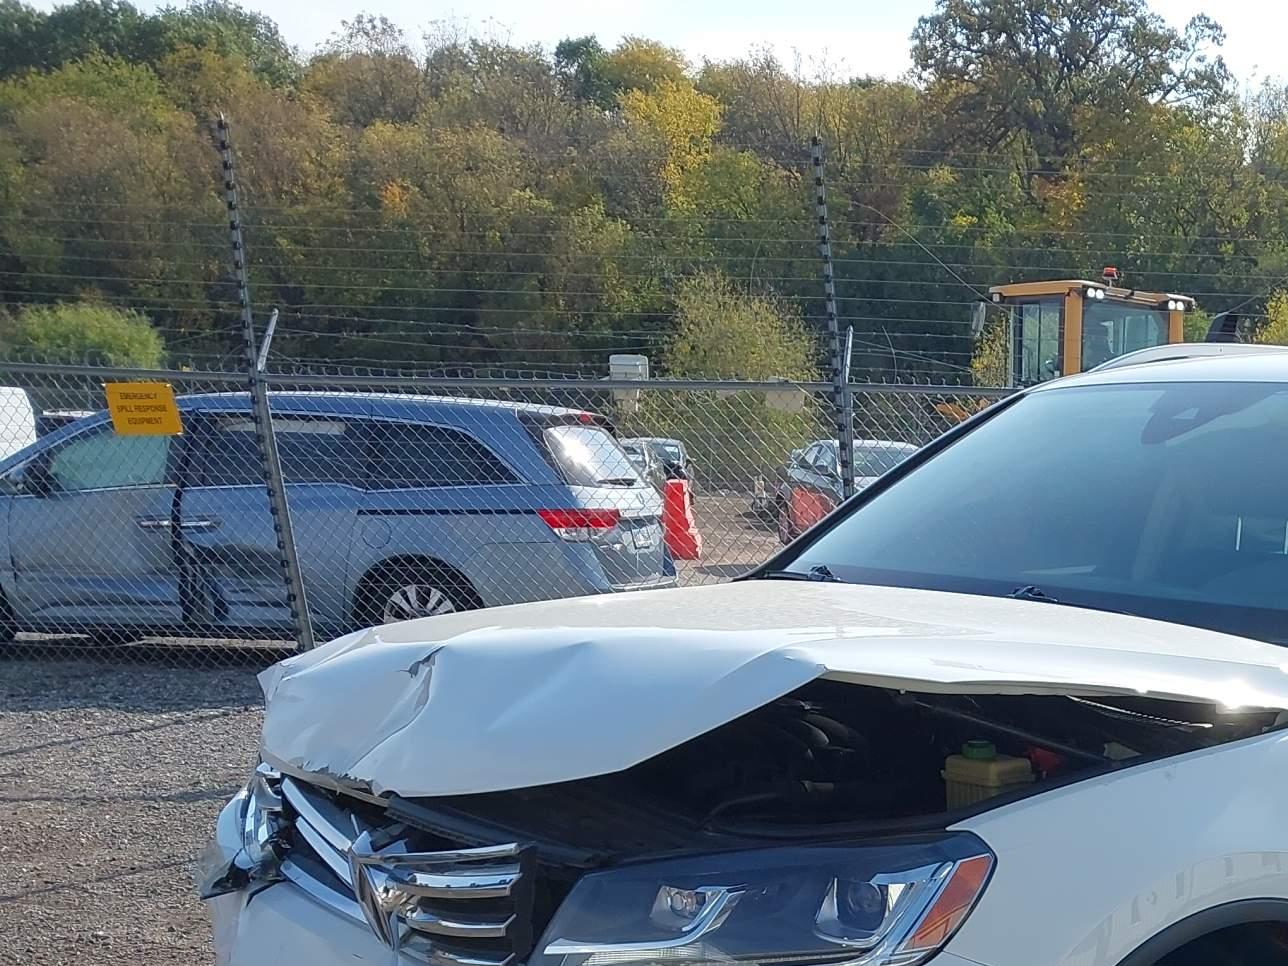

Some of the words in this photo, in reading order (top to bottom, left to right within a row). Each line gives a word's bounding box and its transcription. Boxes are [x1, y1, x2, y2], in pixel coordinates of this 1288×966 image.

[119, 392, 157, 400] EMERGENCY
[116, 404, 133, 413] SPILL
[134, 404, 168, 413] RESPONSE
[127, 417, 162, 425] EQUIPMENT
